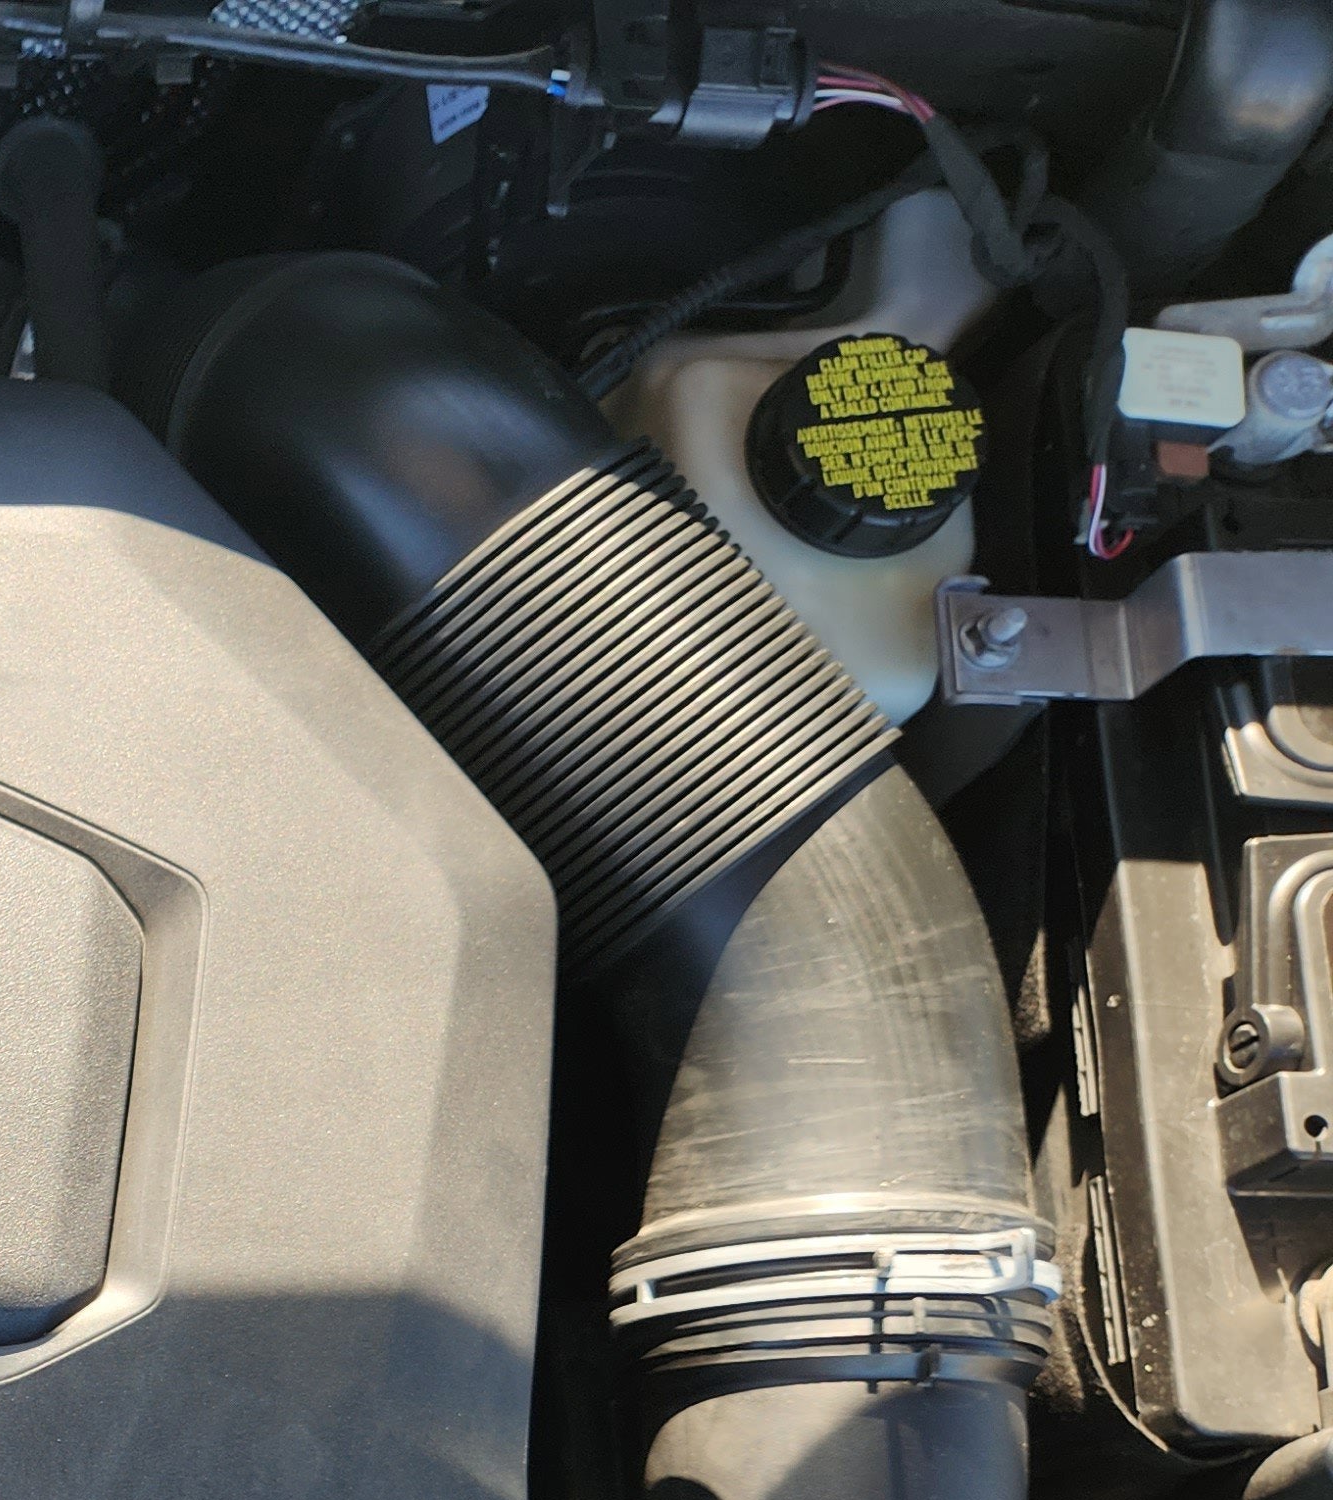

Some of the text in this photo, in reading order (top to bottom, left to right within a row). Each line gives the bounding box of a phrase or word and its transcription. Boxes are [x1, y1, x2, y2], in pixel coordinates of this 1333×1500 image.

[819, 348, 928, 372] CLEAN FILLER CAP
[806, 372, 853, 390] BEFORE
[925, 361, 948, 376] USE
[809, 389, 840, 405] ONLY
[844, 385, 867, 400] DOT
[881, 381, 915, 397] FLUID
[919, 377, 954, 393] FROM
[820, 405, 830, 419] A
[830, 398, 878, 417] SEALED
[904, 411, 965, 431] NETTOYER
[967, 409, 984, 424] LE
[803, 439, 863, 457] BOUCHON
[866, 433, 902, 450] AVANT
[925, 428, 940, 442] LE
[930, 443, 953, 458] QUE
[823, 469, 870, 487] LIQUIDE
[908, 456, 977, 478] PROVENANT
[885, 473, 955, 495] CONTENANT
